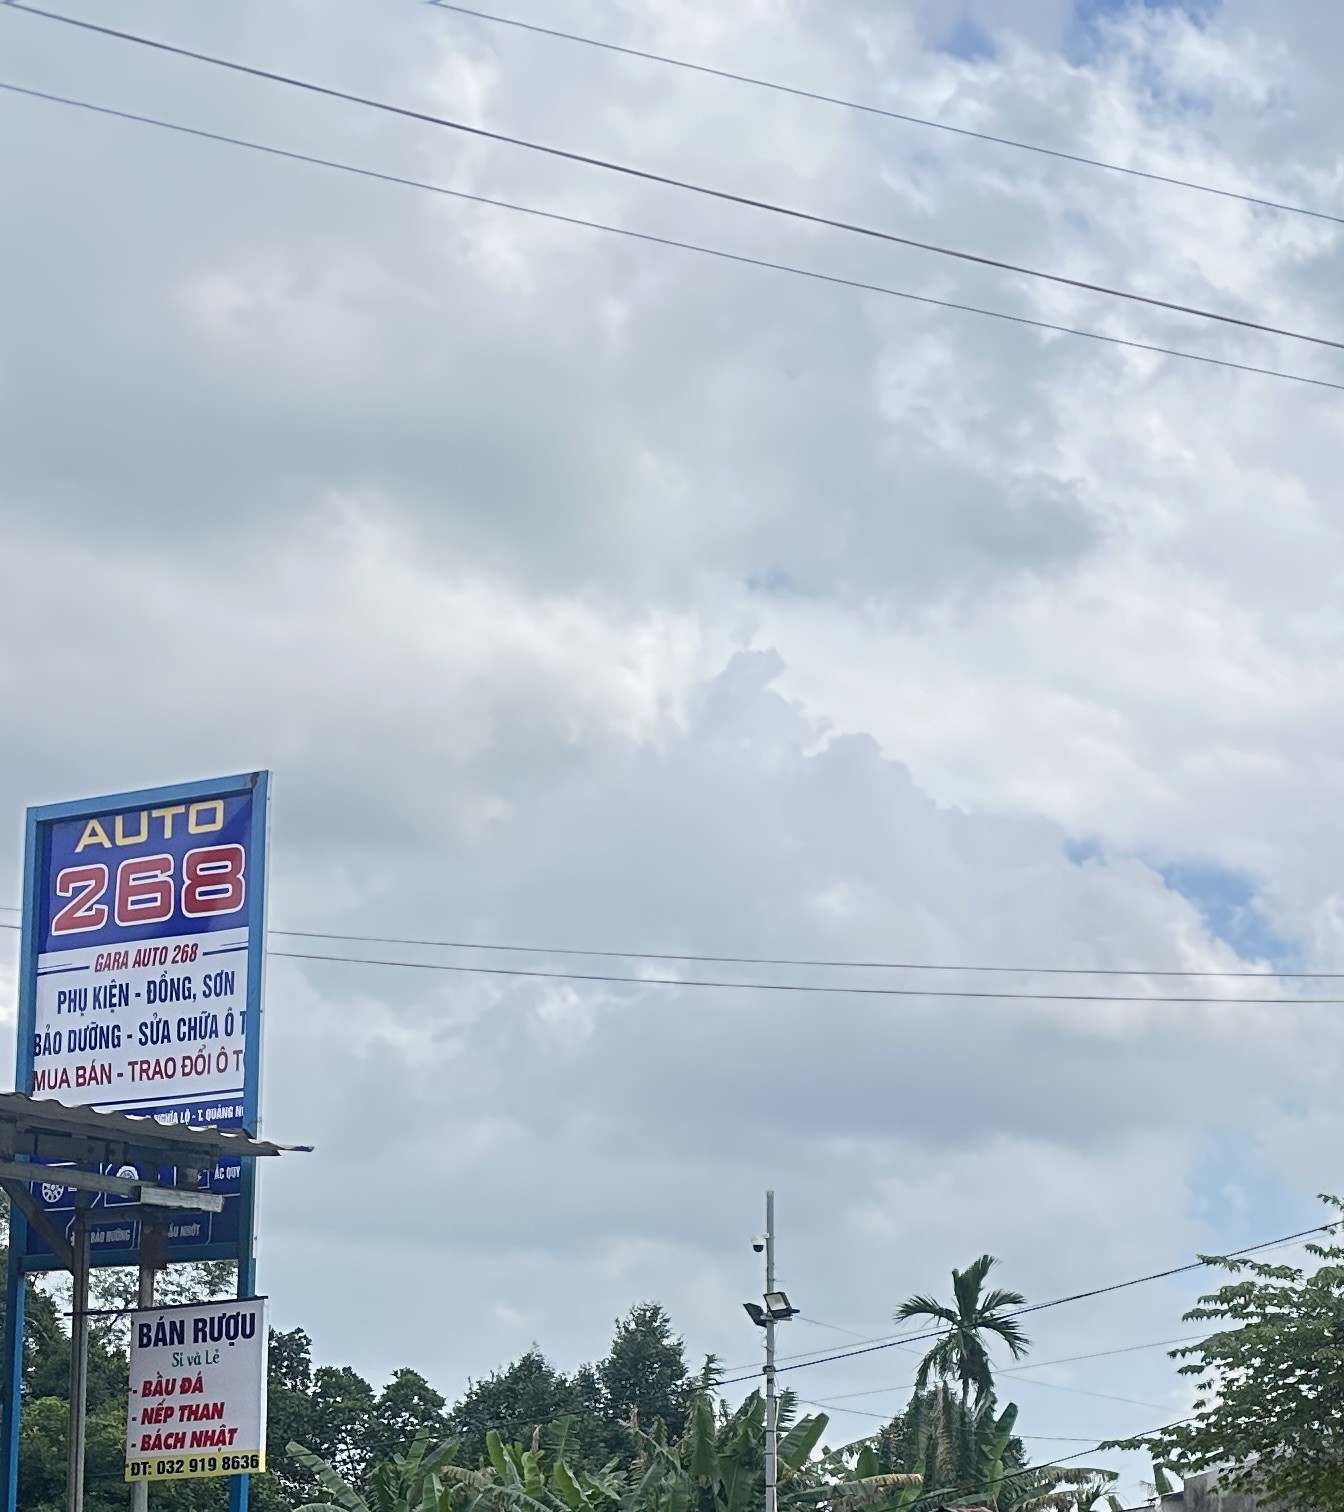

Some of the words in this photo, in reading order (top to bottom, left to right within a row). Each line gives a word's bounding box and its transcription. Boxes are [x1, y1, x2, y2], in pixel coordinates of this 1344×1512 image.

[75, 800, 225, 853] AUTO
[51, 843, 246, 936] 268
[94, 952, 129, 973] GARA
[132, 945, 168, 969] AUTO
[171, 943, 199, 965] 268
[57, 987, 88, 1017] PHỤ
[92, 979, 130, 1013] KIỆN
[146, 970, 197, 1004] ĐỒNG,
[202, 970, 235, 998] SƠN
[34, 1024, 63, 1057] BẢO
[67, 1021, 121, 1053] DƯỠNG
[138, 1012, 171, 1046] SỬA
[177, 1011, 219, 1041] CHỮA
[224, 1007, 235, 1037] Ô
[32, 1067, 71, 1092] MUA
[76, 1058, 112, 1087] BÁN
[128, 1057, 176, 1083] TRAO
[181, 1044, 211, 1077] ĐỔI
[216, 1046, 228, 1073] Ô
[138, 1316, 185, 1348] BÁN
[193, 1312, 256, 1347] RƯỢU
[187, 1350, 200, 1366] và
[141, 1371, 177, 1398] BẦU
[180, 1371, 204, 1395] ĐÁ
[141, 1398, 174, 1425] NẾP
[178, 1402, 225, 1422] THAN
[140, 1428, 186, 1451] BÁCH
[190, 1424, 239, 1452] NHẬT
[131, 1461, 152, 1476] ĐT:
[156, 1459, 184, 1474] 032
[189, 1457, 217, 1472] 919
[222, 1454, 259, 1471] 8636
